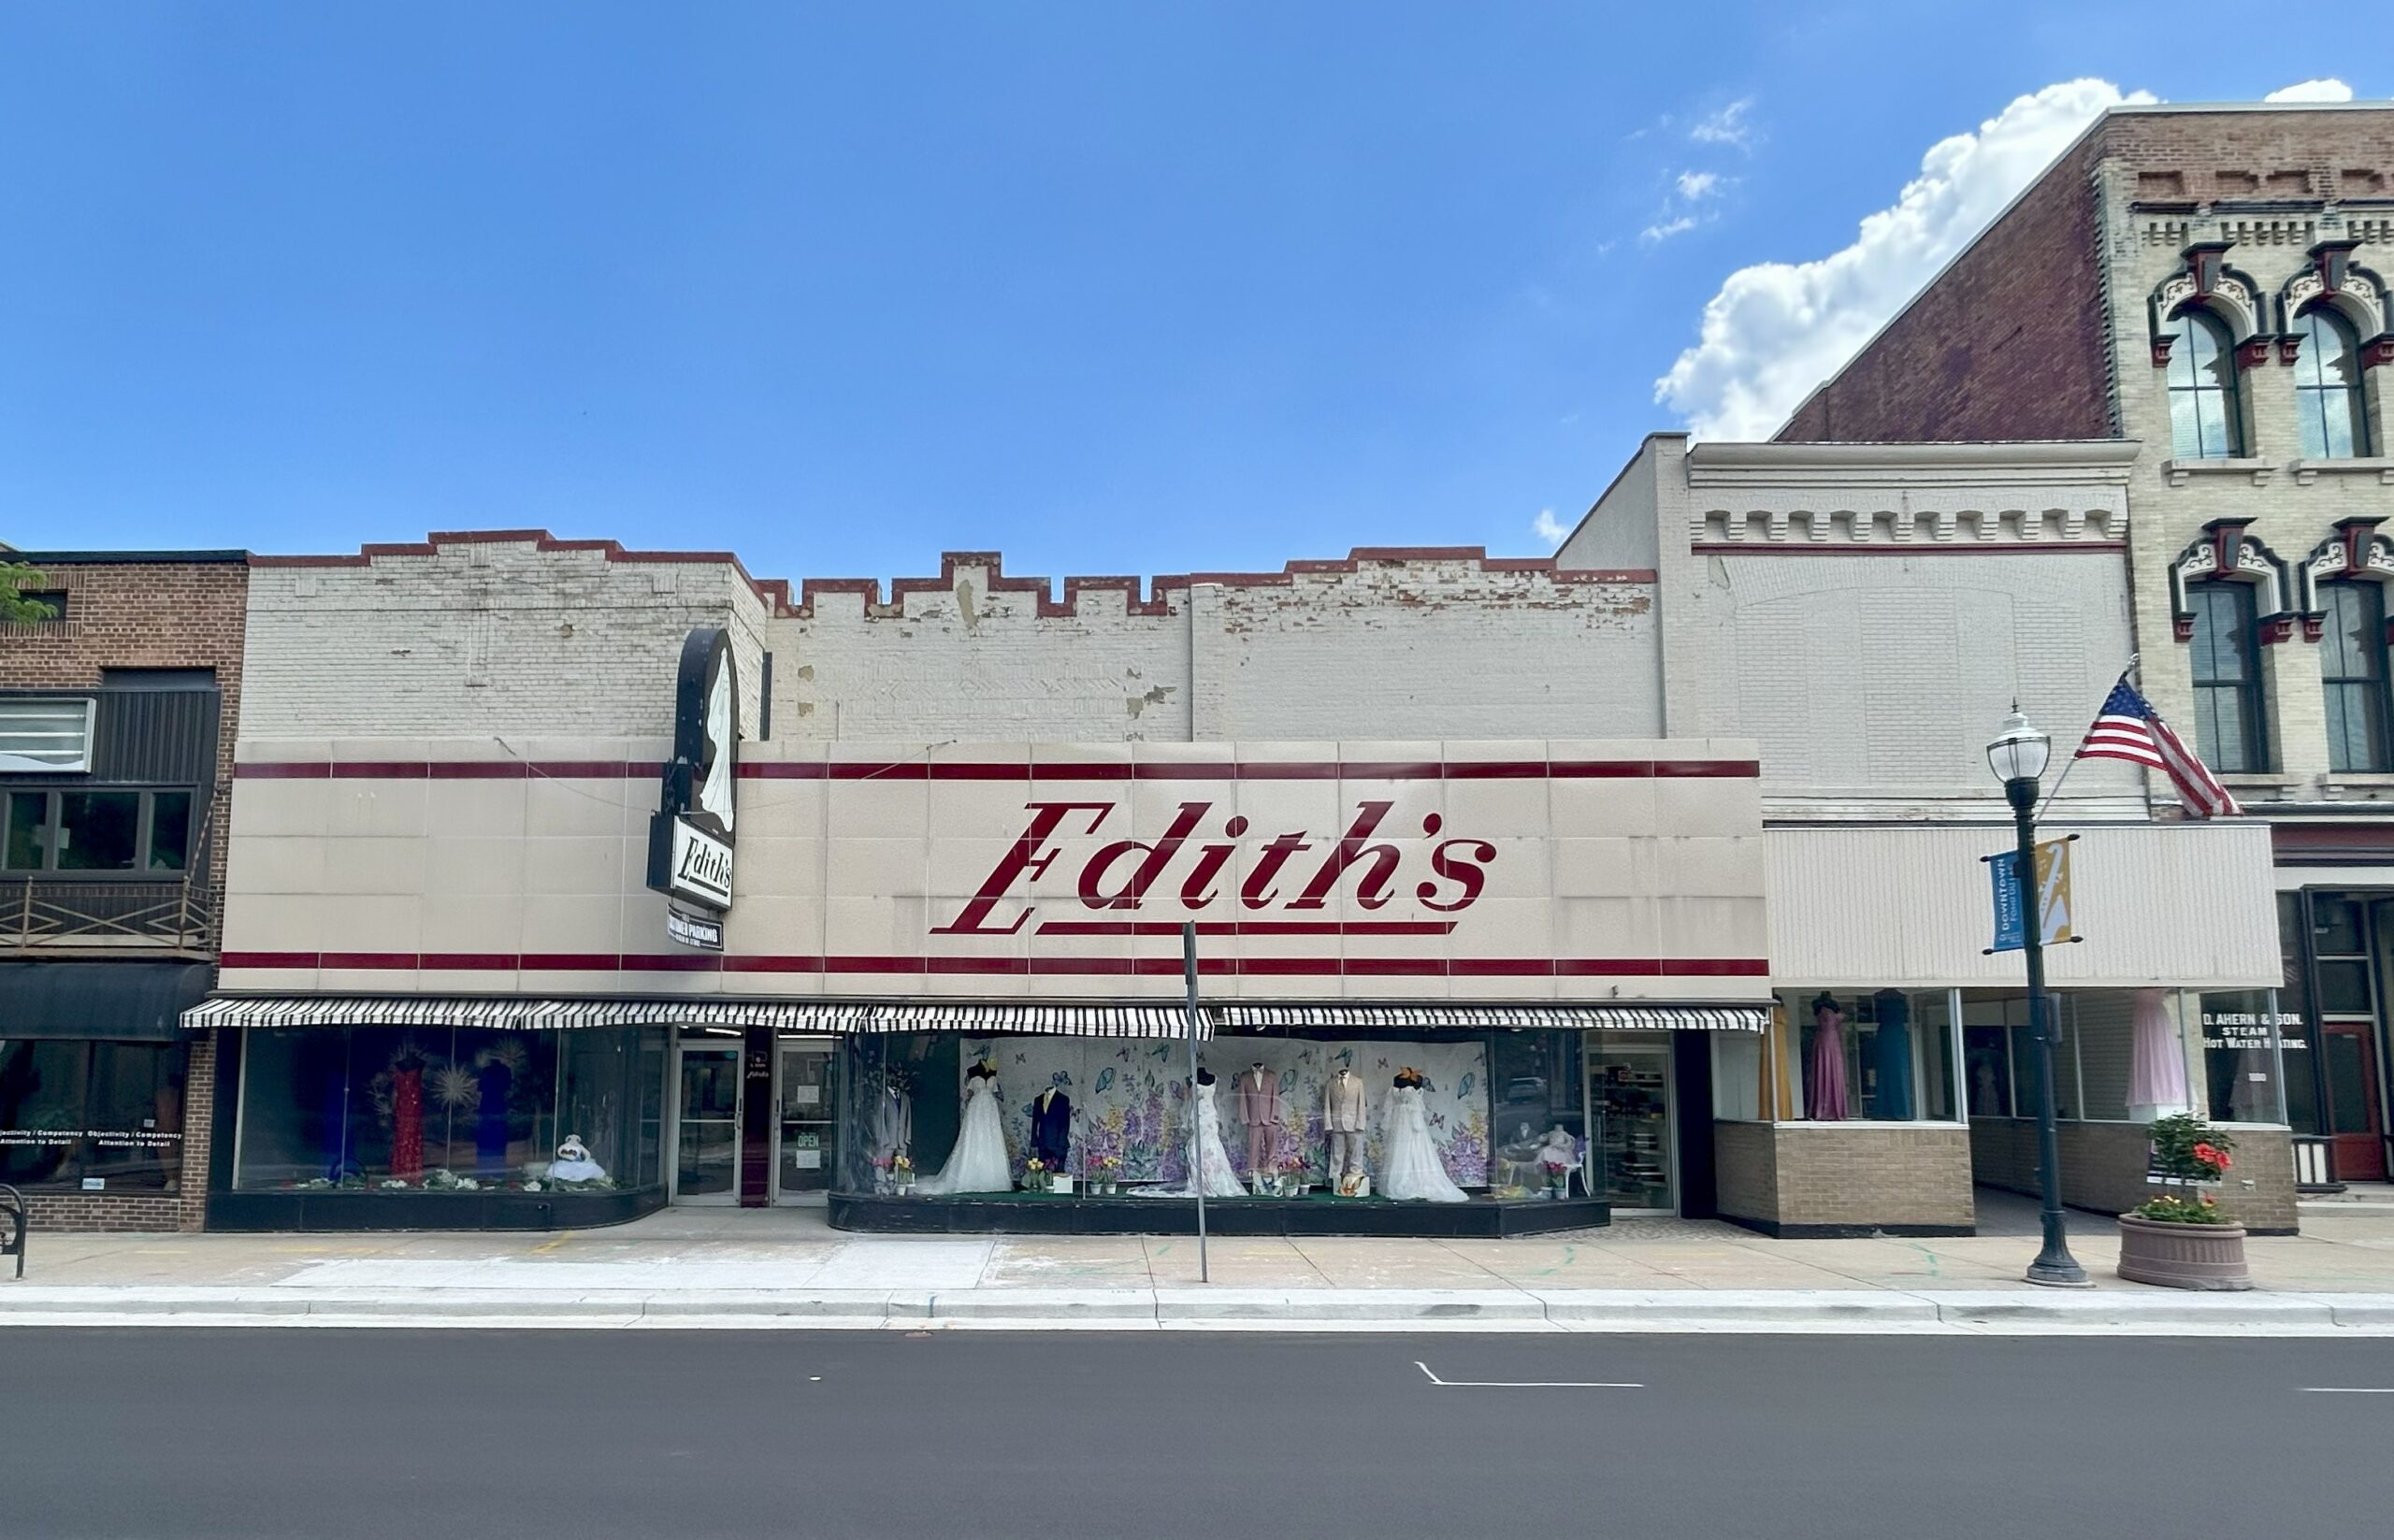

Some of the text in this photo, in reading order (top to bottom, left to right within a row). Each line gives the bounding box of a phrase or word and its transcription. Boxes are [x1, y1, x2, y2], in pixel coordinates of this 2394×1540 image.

[678, 836, 731, 888] Edith's
[929, 801, 1496, 934] Edith's
[1997, 858, 2010, 930] DOWNTOWN
[2216, 1014, 2256, 1025] AHERN
[2222, 1027, 2268, 1036] STEAM
[87, 1130, 130, 1139] Objectivity
[136, 1131, 182, 1140] Competency
[797, 1135, 819, 1147] OPEN
